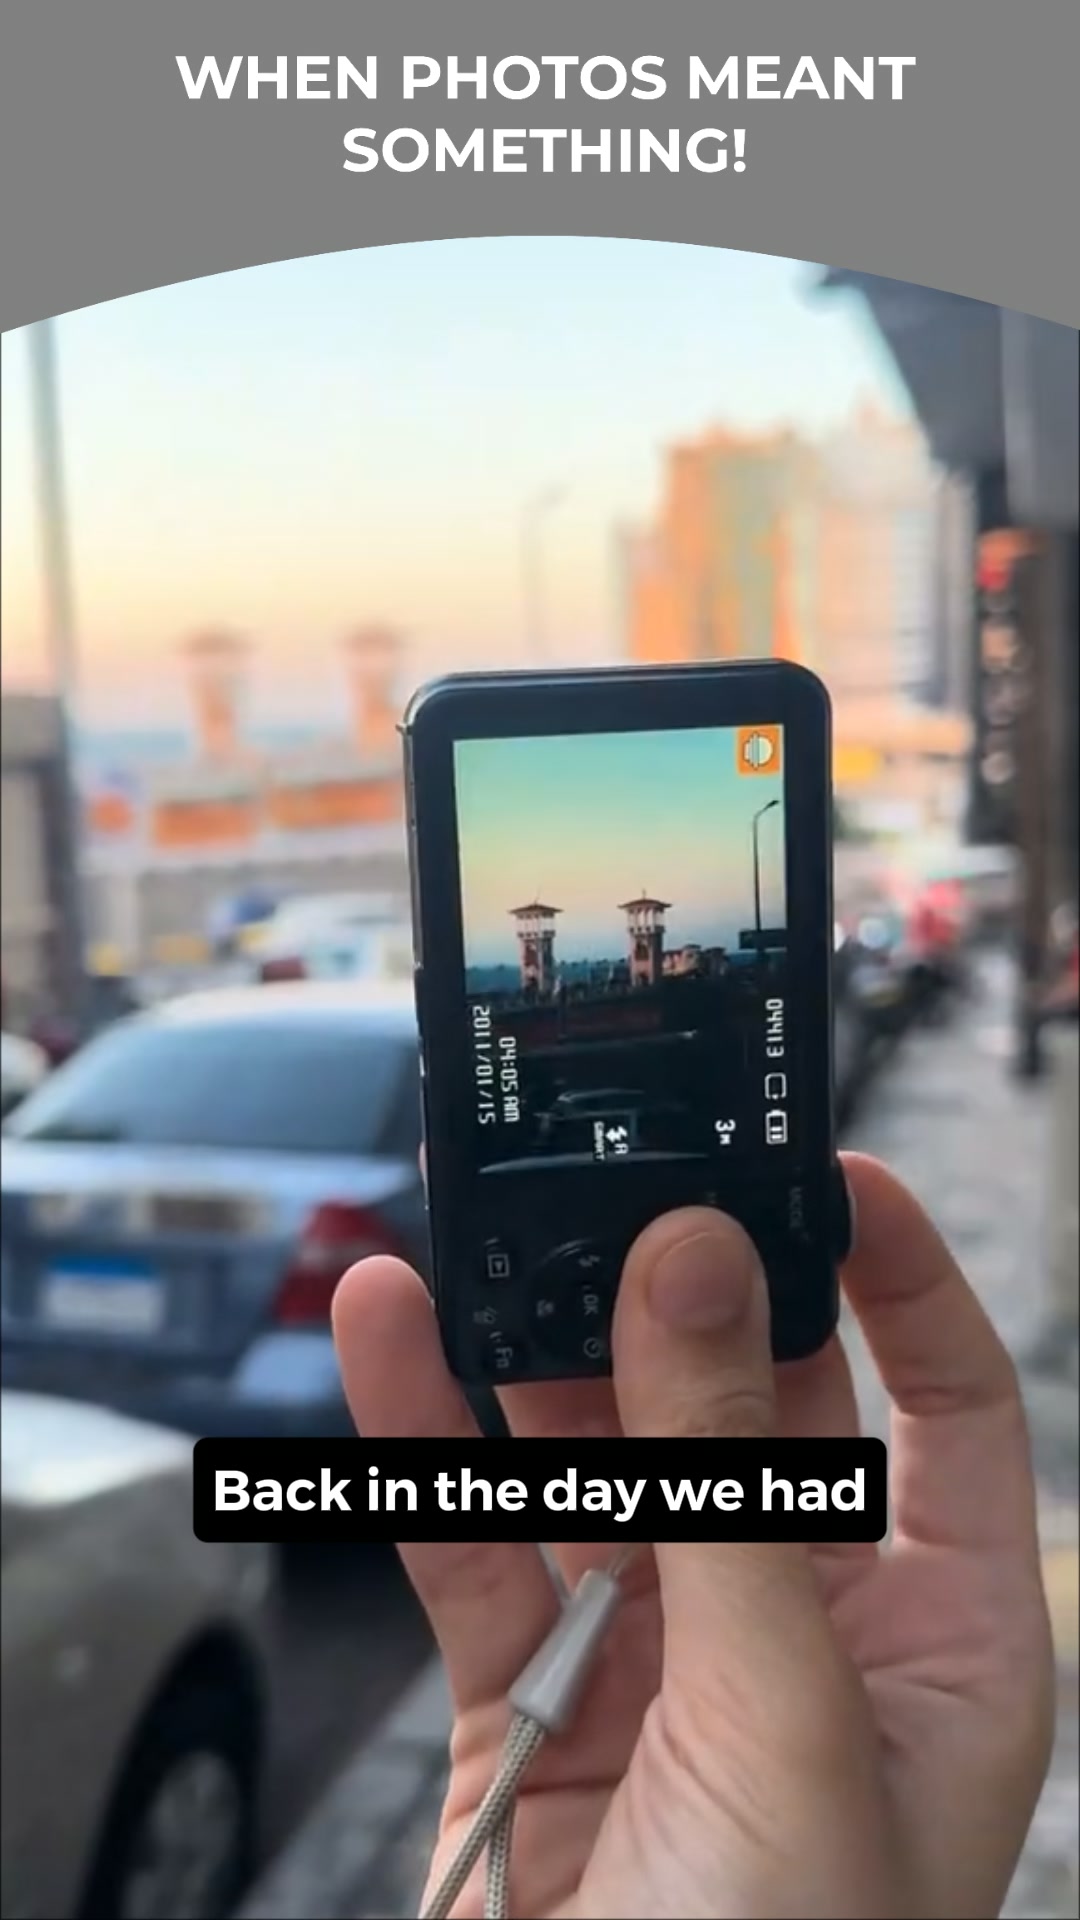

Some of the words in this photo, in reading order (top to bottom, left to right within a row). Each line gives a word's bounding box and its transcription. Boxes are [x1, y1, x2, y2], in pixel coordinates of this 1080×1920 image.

[765, 998, 785, 1058] 04413
[473, 1005, 496, 1124] 2011/01/15
[499, 1036, 518, 1093] 04:05
[503, 1095, 520, 1123] AM
[583, 1295, 598, 1316] OK
[495, 1346, 514, 1369] Fn
